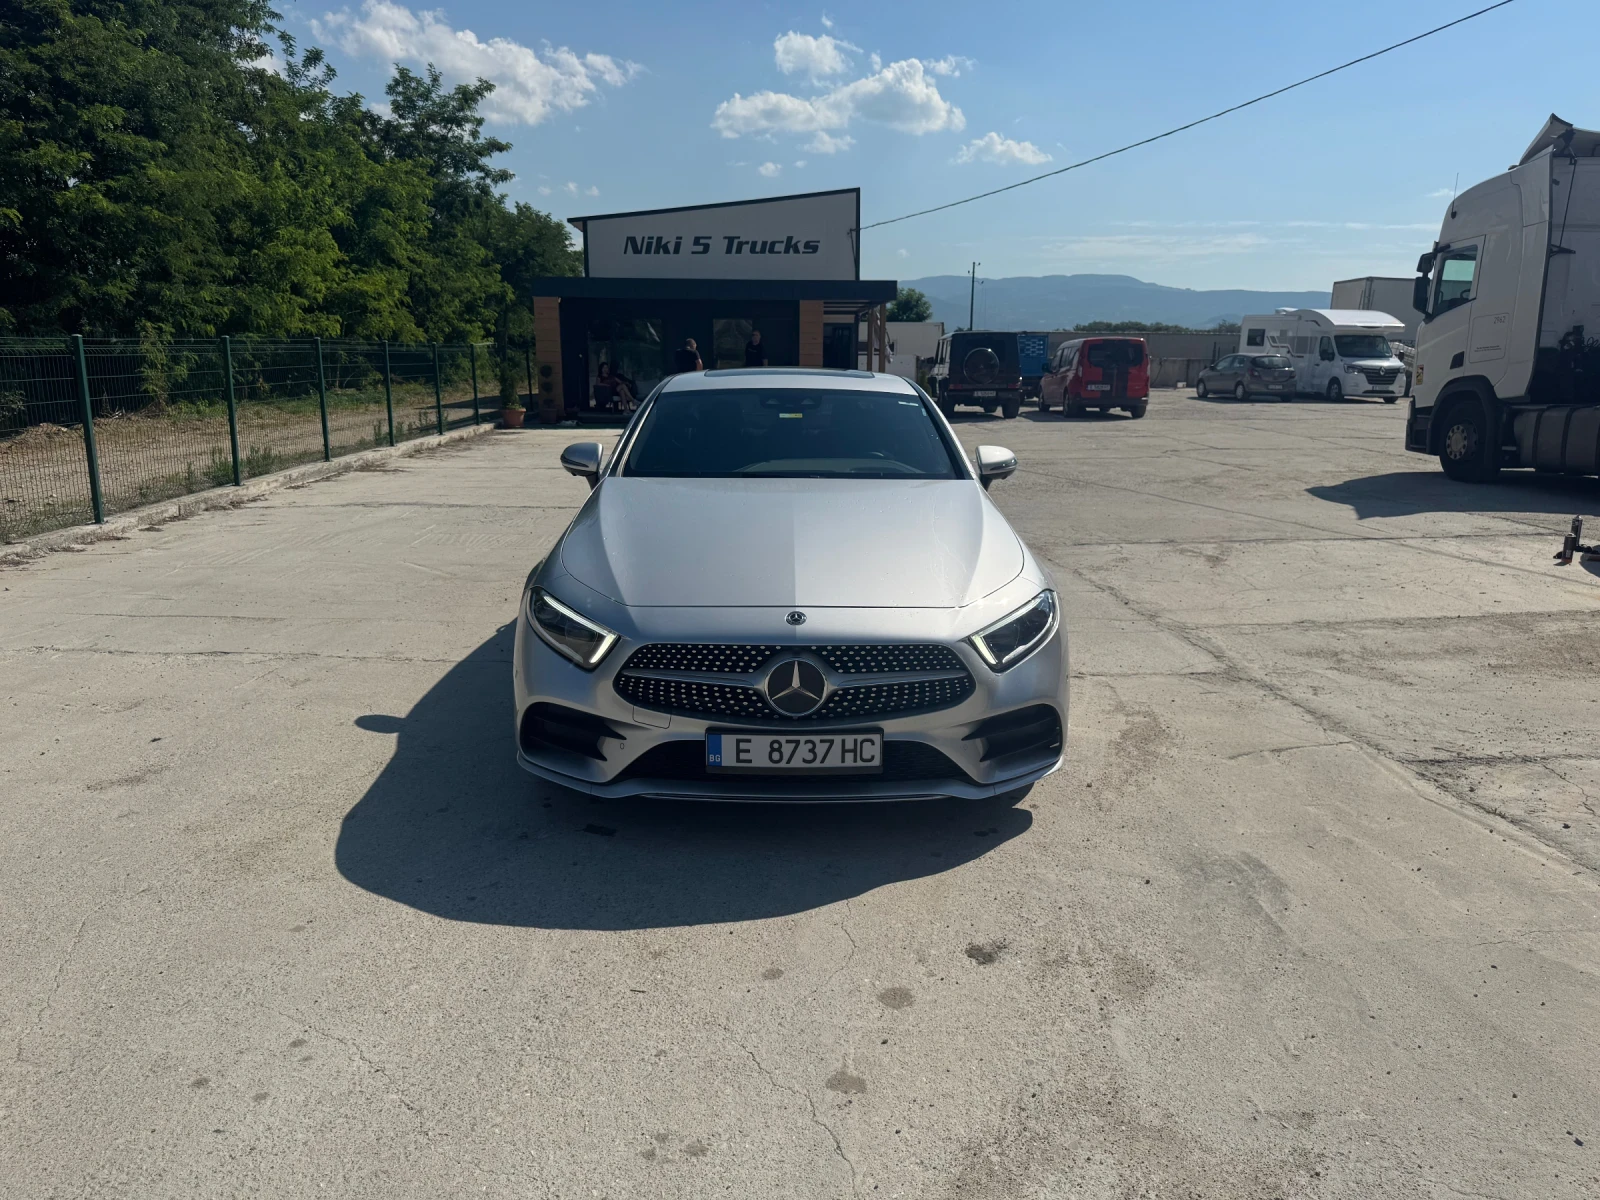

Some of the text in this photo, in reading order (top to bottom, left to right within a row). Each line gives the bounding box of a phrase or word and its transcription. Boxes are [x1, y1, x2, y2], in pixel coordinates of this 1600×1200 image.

[623, 235, 821, 255] Niki 5 Trucks
[709, 754, 721, 762] BG
[735, 738, 876, 765] E 8737 HC
